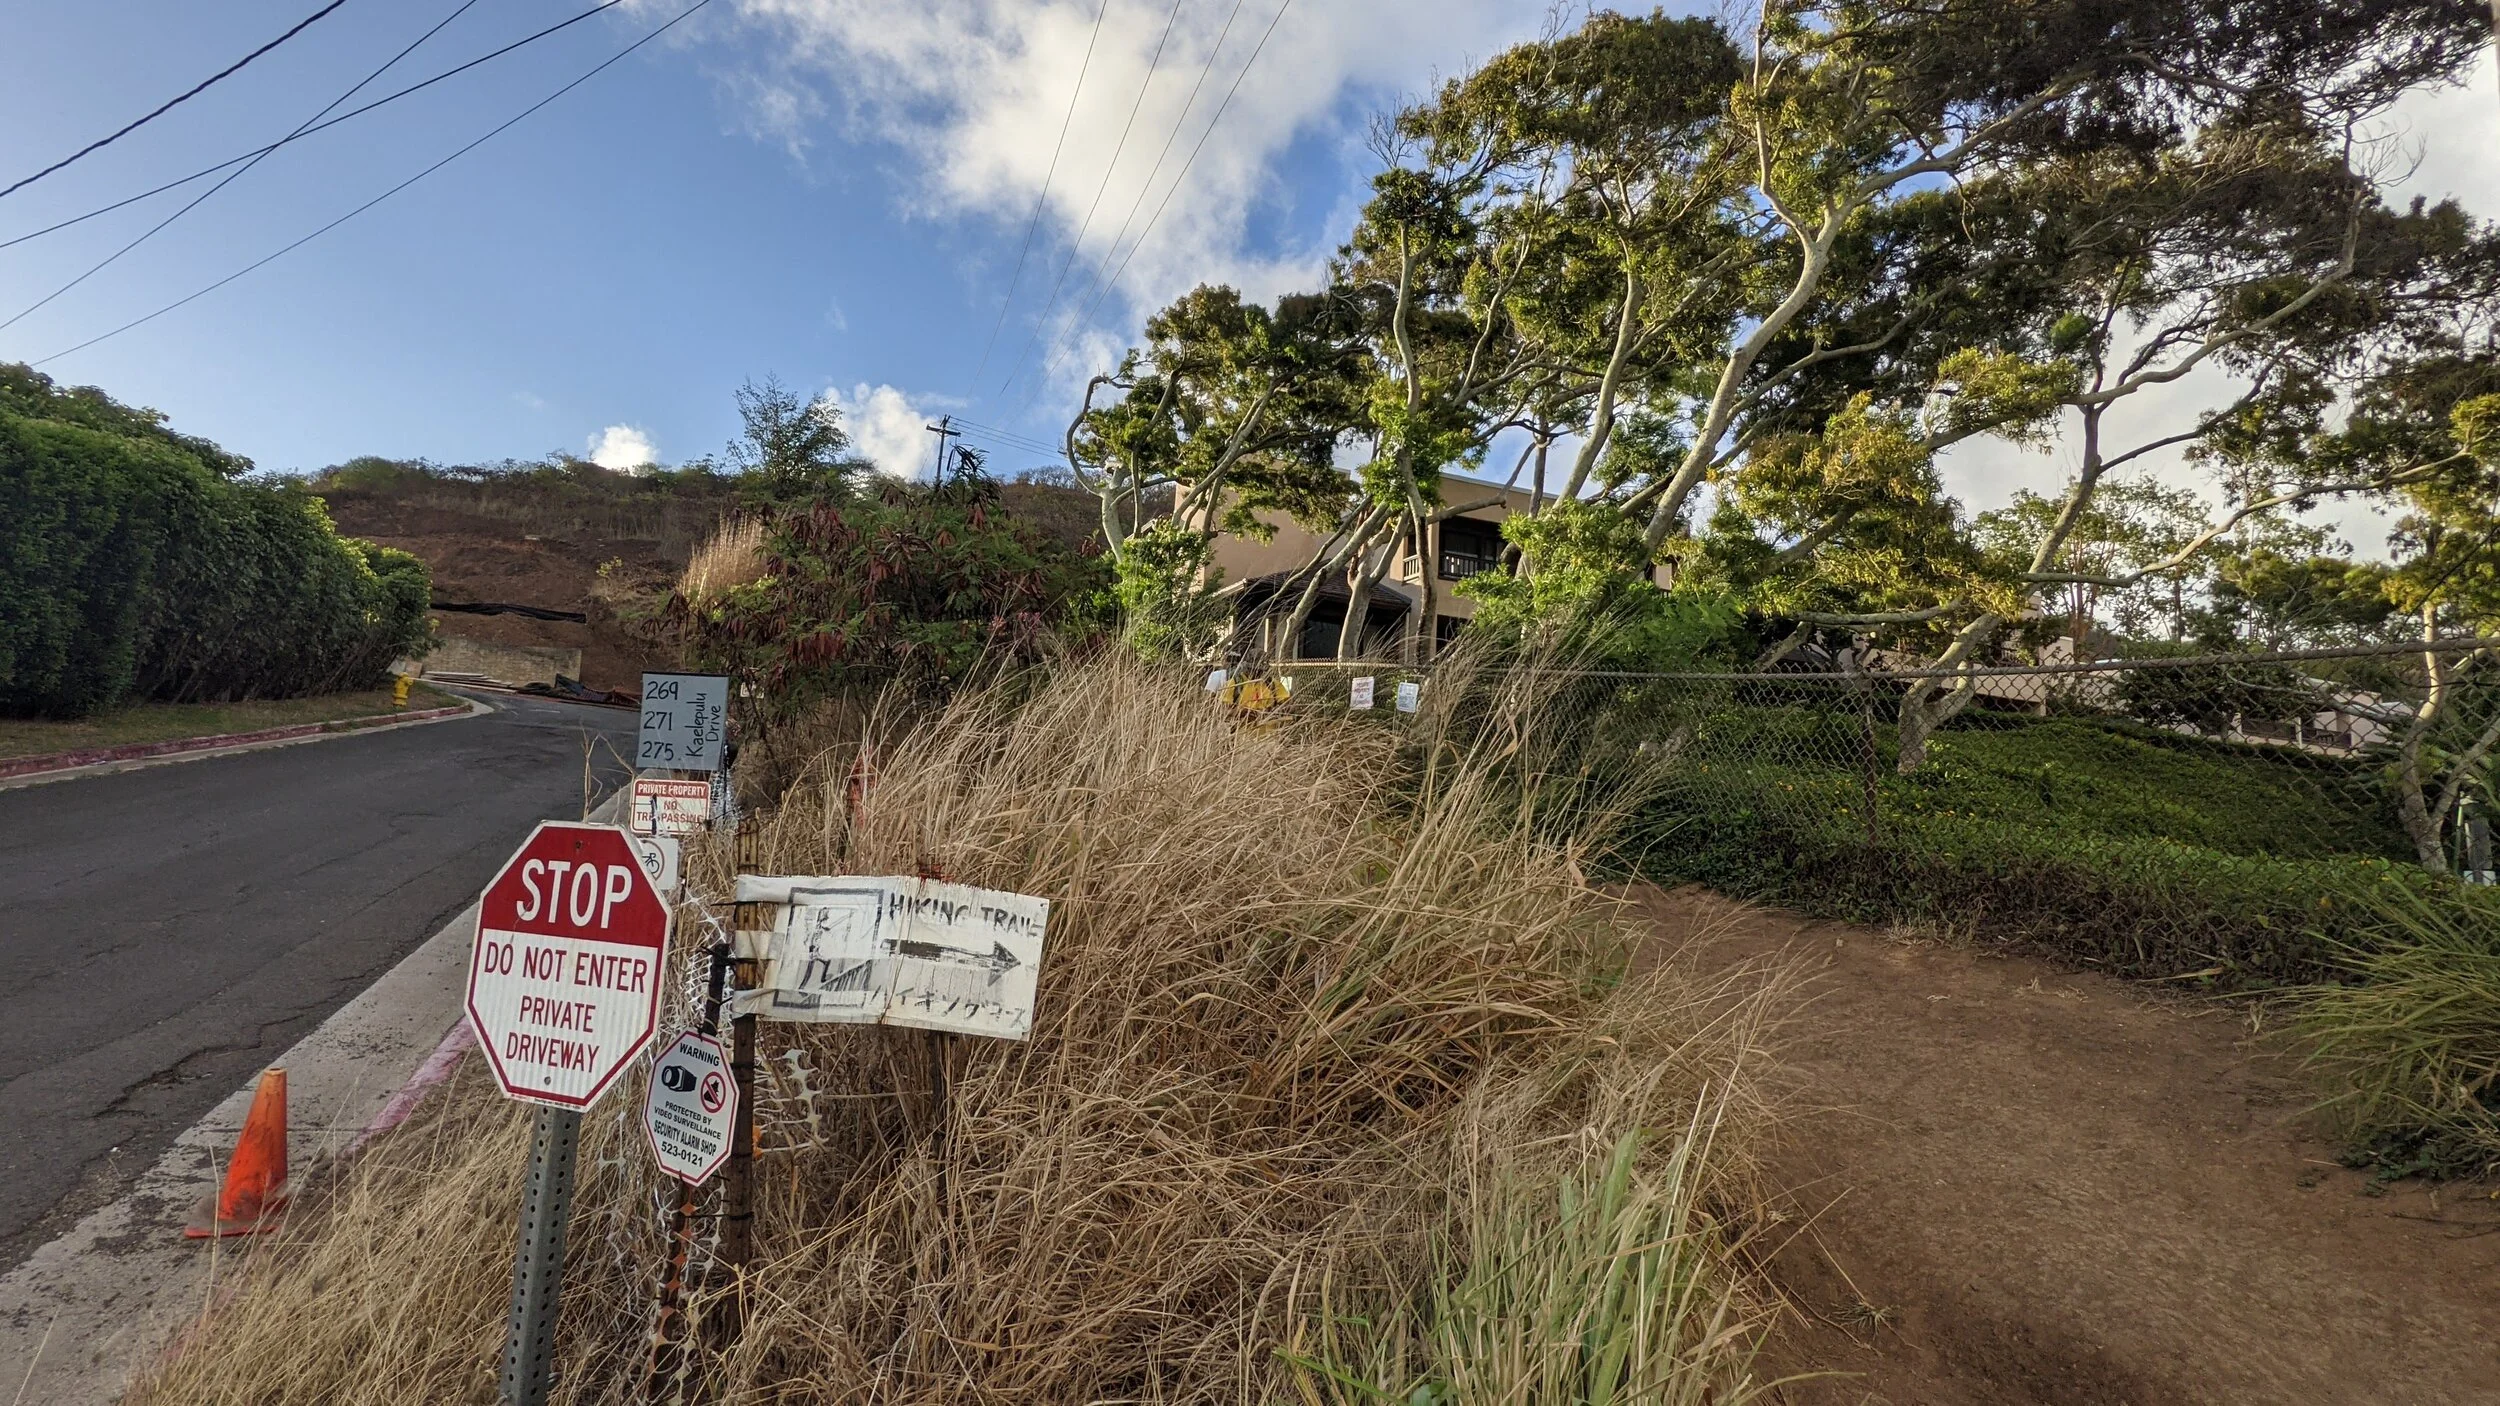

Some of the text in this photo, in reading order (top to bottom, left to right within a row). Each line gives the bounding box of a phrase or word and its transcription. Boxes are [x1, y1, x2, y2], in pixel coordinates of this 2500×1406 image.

[645, 680, 679, 701] 269
[643, 710, 673, 731] 271
[684, 692, 709, 757] Kaelepulu
[705, 705, 721, 742] Drive
[641, 740, 674, 761] 275
[638, 783, 706, 797] PRIVATE PROPERTY
[663, 800, 678, 810] NO
[636, 811, 704, 824] TRPASSING
[516, 858, 633, 929] STOP
[889, 892, 969, 926] HIKING
[484, 941, 648, 994] DO NOT ENTER
[519, 995, 596, 1033] PRIVATE
[505, 1031, 600, 1073] DRIVEWAY
[679, 1042, 720, 1067] WARNING
[654, 1106, 722, 1140] VIDEO SURVEILLANCE
[665, 1100, 712, 1126] PROTECTED BY
[653, 1119, 717, 1157] SECURITY ALARM SHOP
[661, 1140, 703, 1168] 523-0121
